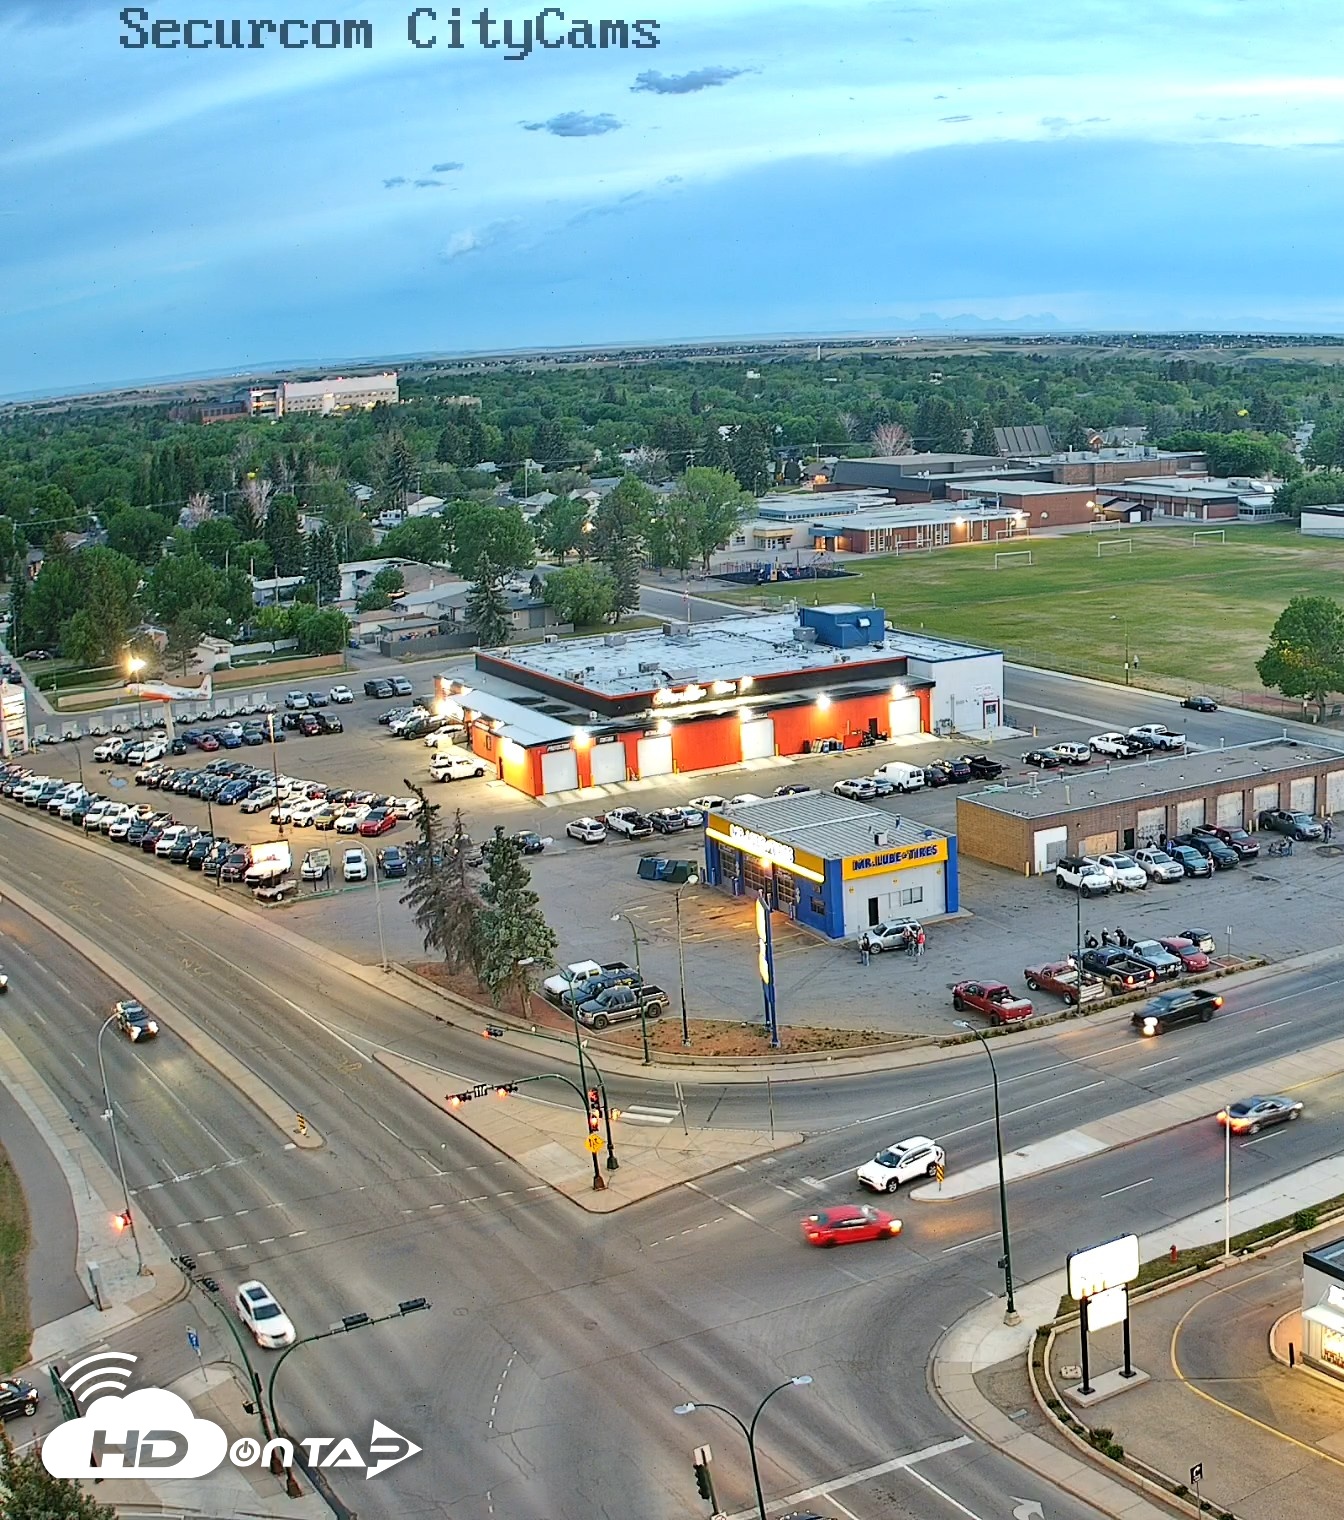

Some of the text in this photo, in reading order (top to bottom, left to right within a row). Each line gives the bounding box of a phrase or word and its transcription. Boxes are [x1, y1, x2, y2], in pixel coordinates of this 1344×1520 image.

[852, 857, 876, 871] MR.
[875, 852, 902, 867] LUBE
[907, 844, 938, 861] TIRES
